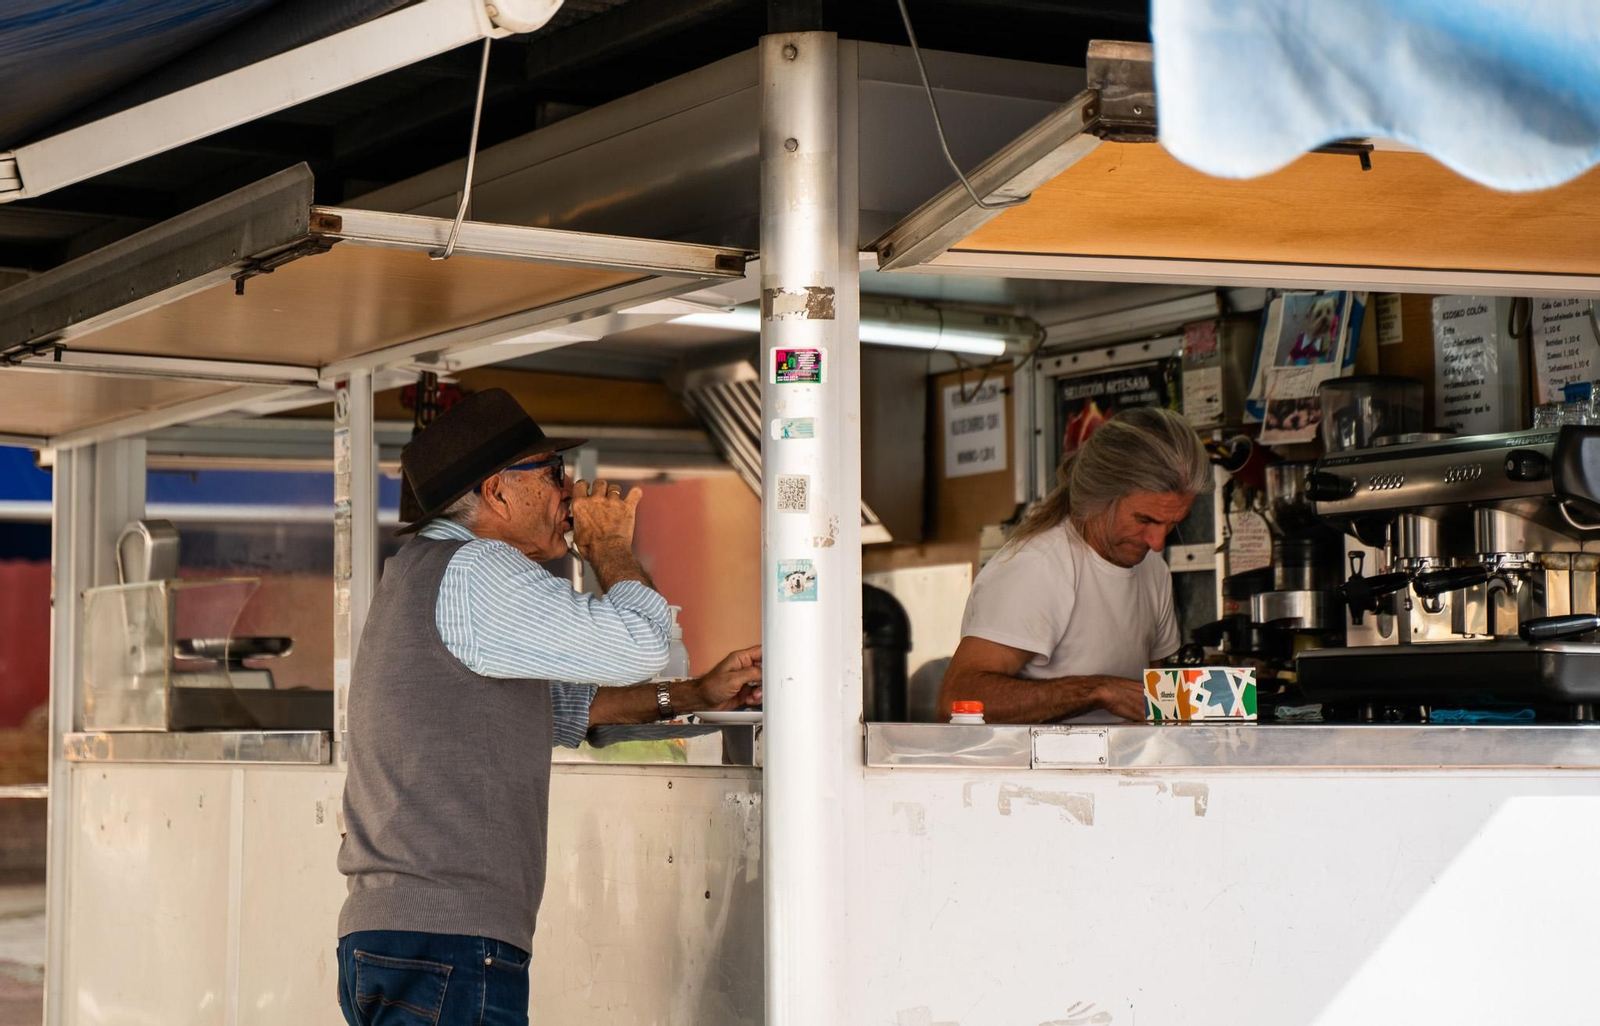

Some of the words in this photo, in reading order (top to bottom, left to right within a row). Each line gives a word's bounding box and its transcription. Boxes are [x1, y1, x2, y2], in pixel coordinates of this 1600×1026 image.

[1442, 308, 1465, 320] KIOSKO
[1547, 352, 1562, 360] Zumos
[1473, 390, 1481, 399] del
[1505, 434, 1552, 446] FUTURMAT
